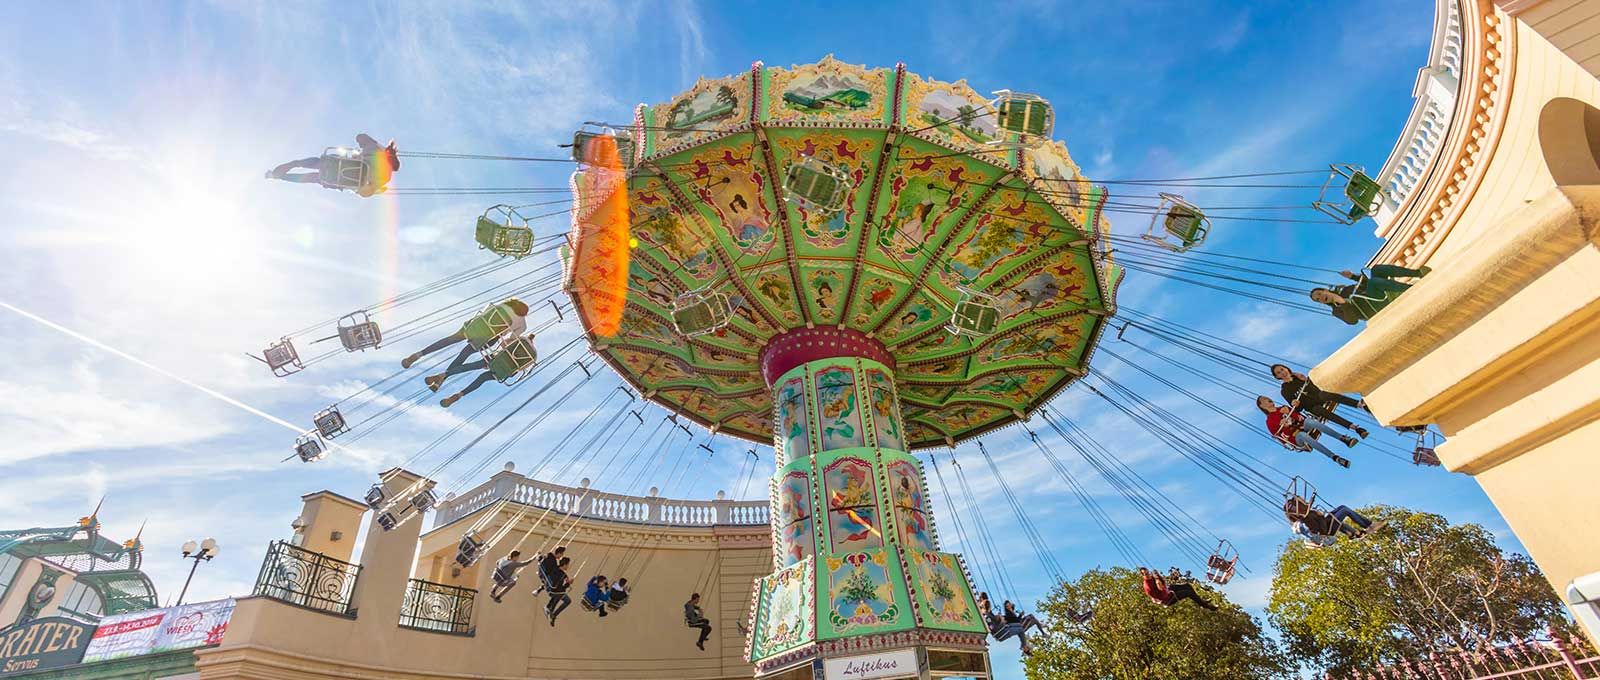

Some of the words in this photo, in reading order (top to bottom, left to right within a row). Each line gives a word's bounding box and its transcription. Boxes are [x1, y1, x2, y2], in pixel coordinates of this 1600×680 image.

[166, 623, 195, 635] WIESN
[0, 622, 84, 658] RATER
[2, 658, 40, 673] Servus
[843, 658, 898, 677] Luftikus
